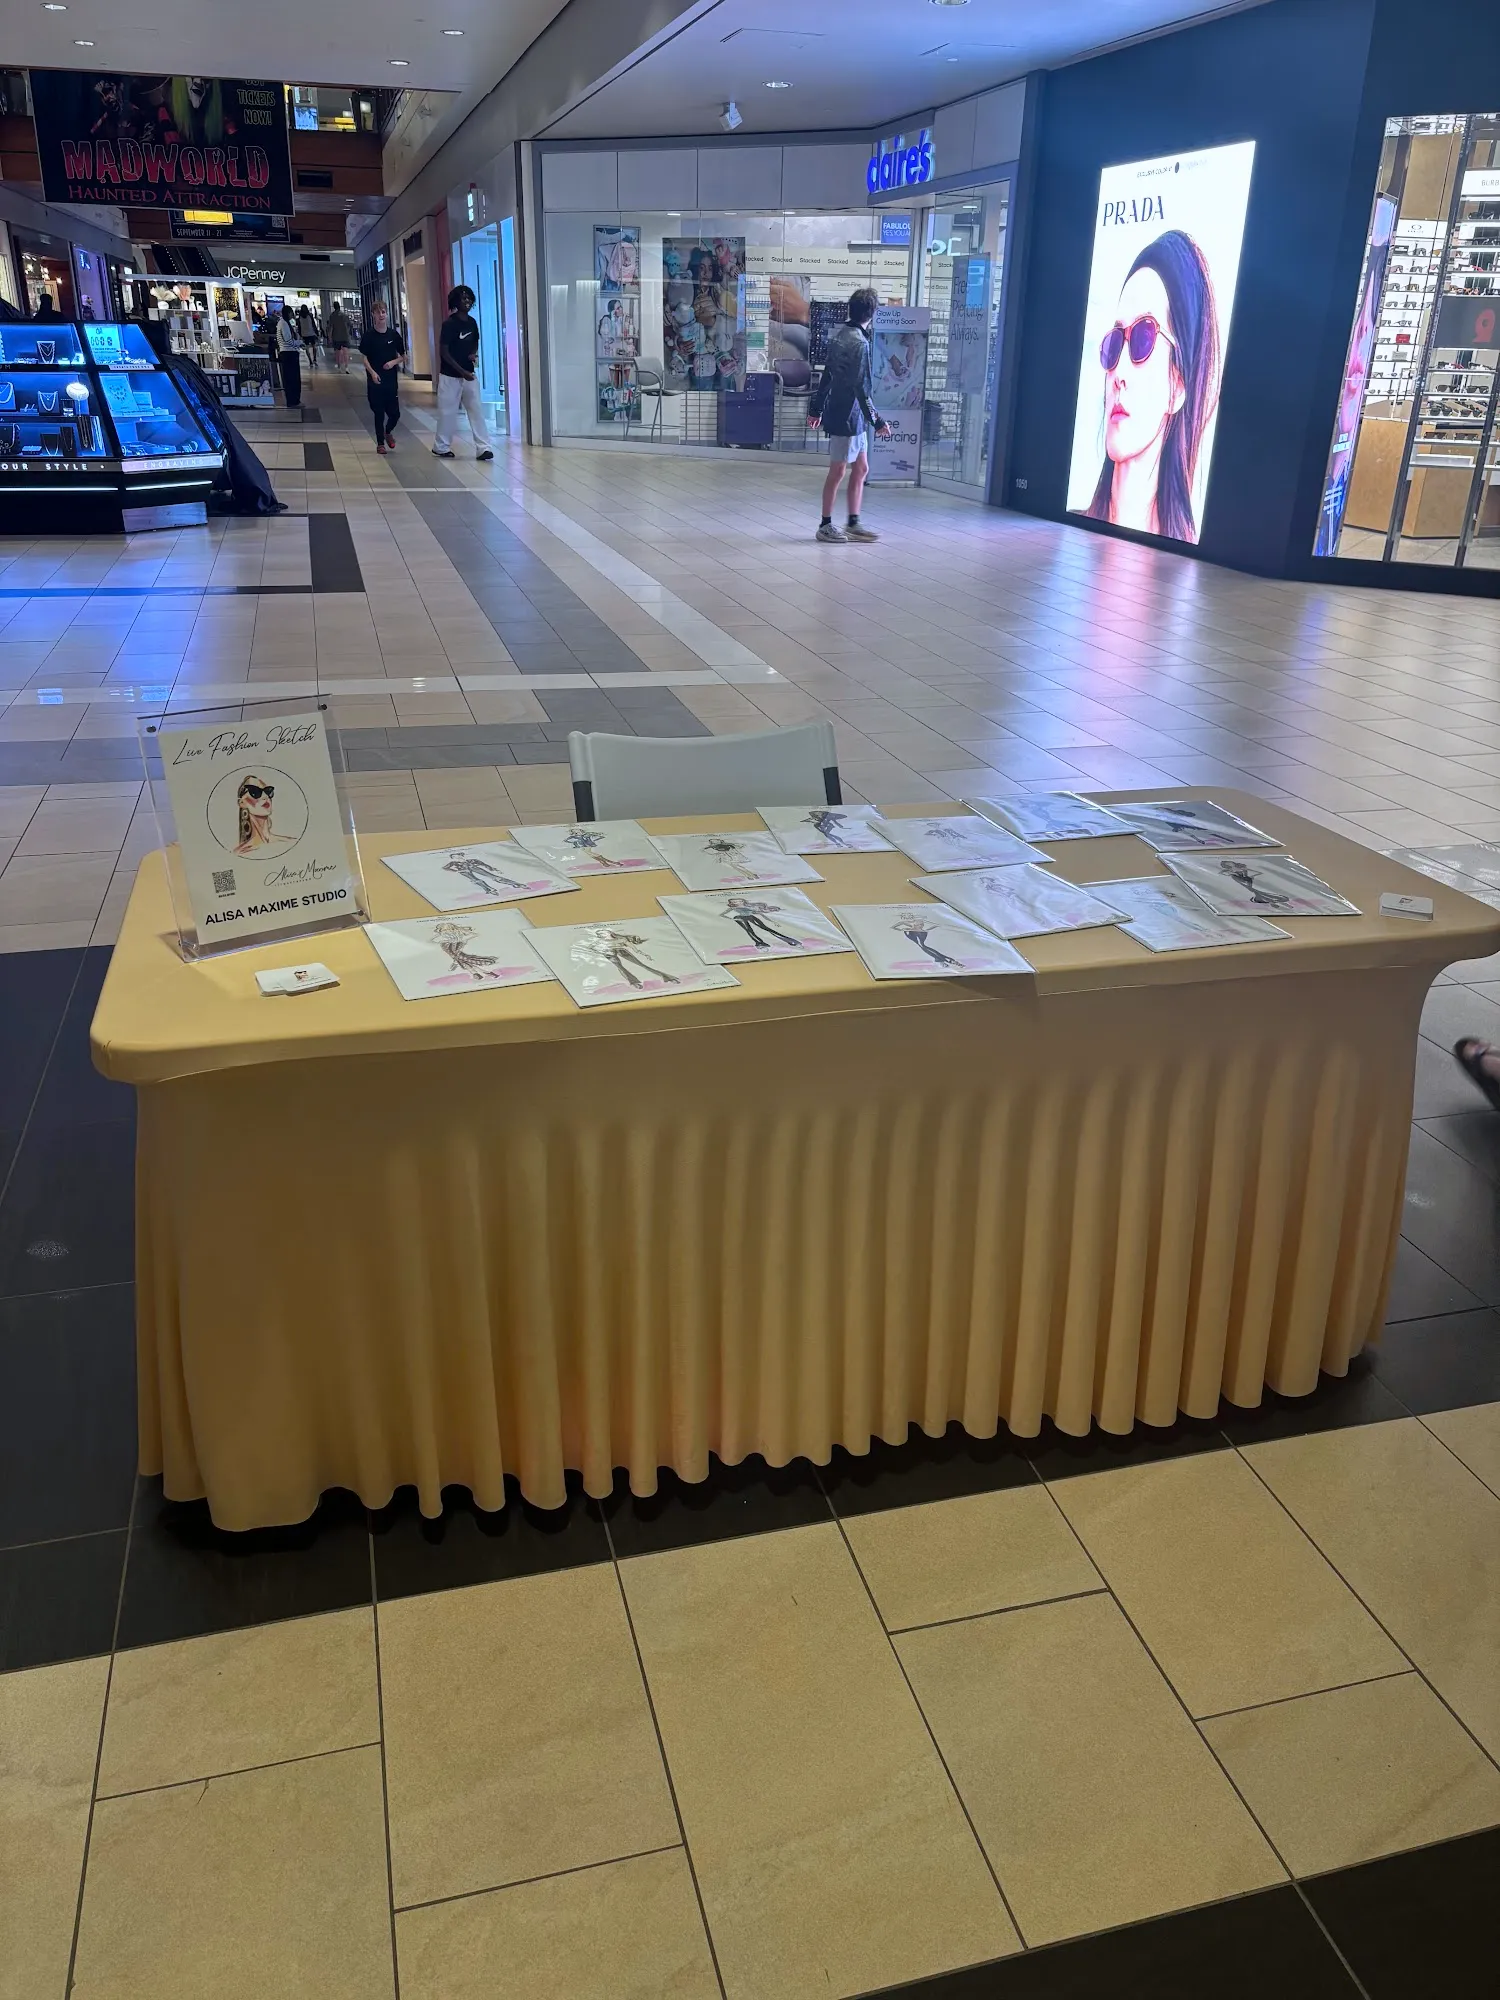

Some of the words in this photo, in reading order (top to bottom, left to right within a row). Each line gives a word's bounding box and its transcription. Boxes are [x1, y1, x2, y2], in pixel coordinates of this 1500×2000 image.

[237, 89, 276, 107] TICKETS
[244, 109, 272, 126] NOW!
[61, 138, 269, 189] MADWORLD
[867, 128, 934, 193] claire's
[68, 184, 158, 201] HAUNTED
[163, 188, 271, 209] ATTRACTION
[1102, 195, 1165, 227] PRADA
[176, 228, 205, 237] SEPTEMBER
[223, 266, 286, 284] JCPenney
[876, 318, 900, 326] Coming
[892, 310, 901, 318] Up
[46, 463, 88, 471] STYLE
[208, 731, 260, 761] Fashion
[265, 723, 317, 753] Sketch
[205, 909, 245, 926] ALISA
[248, 898, 299, 917] MAXIME
[301, 889, 347, 906] STUDIO
